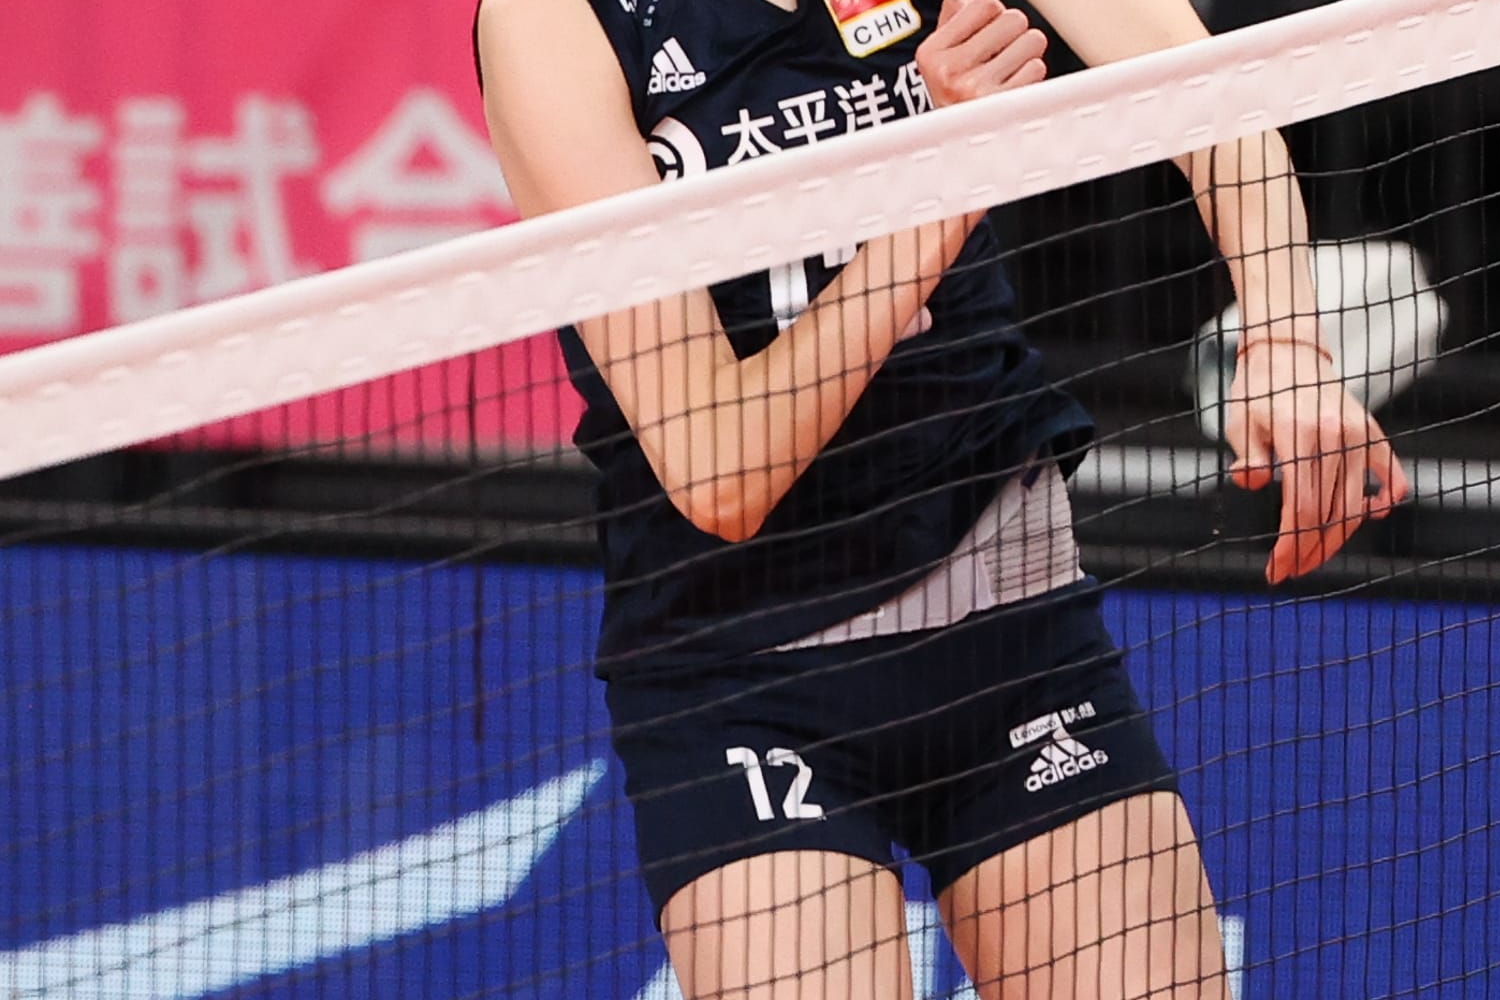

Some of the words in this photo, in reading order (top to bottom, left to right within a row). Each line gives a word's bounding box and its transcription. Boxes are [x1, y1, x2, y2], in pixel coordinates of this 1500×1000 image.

[853, 7, 912, 45] CHN
[647, 70, 707, 96] adidas
[726, 746, 824, 821] 12
[1025, 748, 1109, 792] adidas
